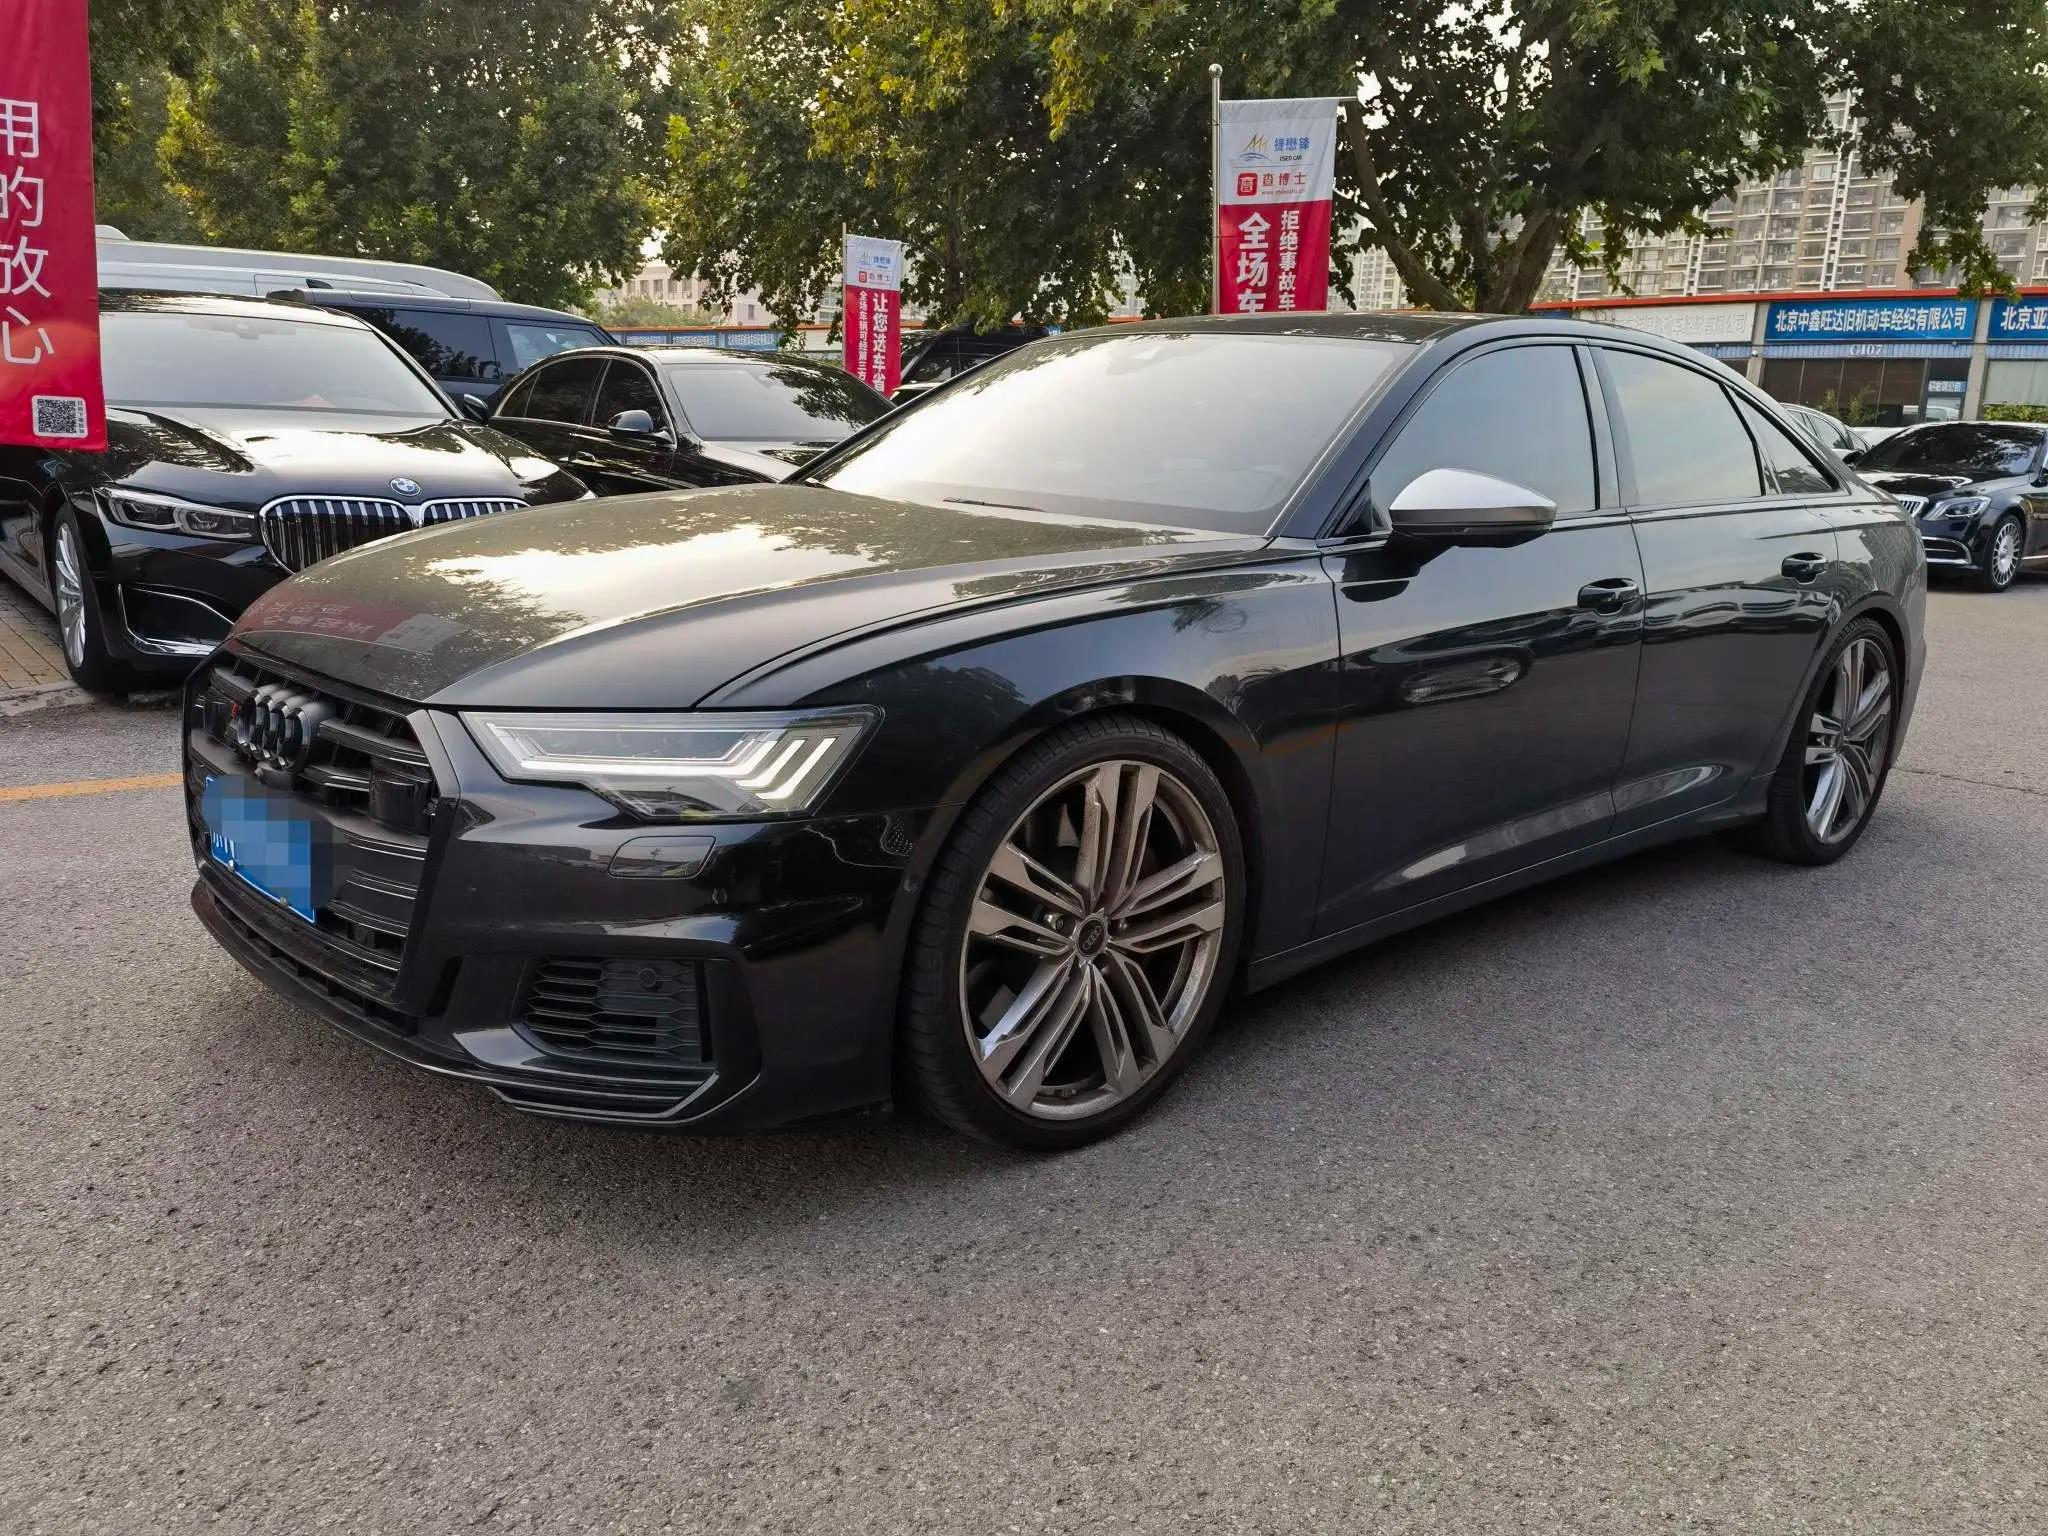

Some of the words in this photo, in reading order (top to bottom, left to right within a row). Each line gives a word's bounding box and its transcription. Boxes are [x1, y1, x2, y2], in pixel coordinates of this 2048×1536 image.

[1236, 212, 1271, 313] 全场车
[1278, 210, 1300, 312] 拒绝事故车
[872, 293, 889, 392] 让您选车省
[1775, 307, 1967, 333] 北京中鑫旺达旧机动车经纪有限公司
[2000, 306, 2048, 331] 北京亚
